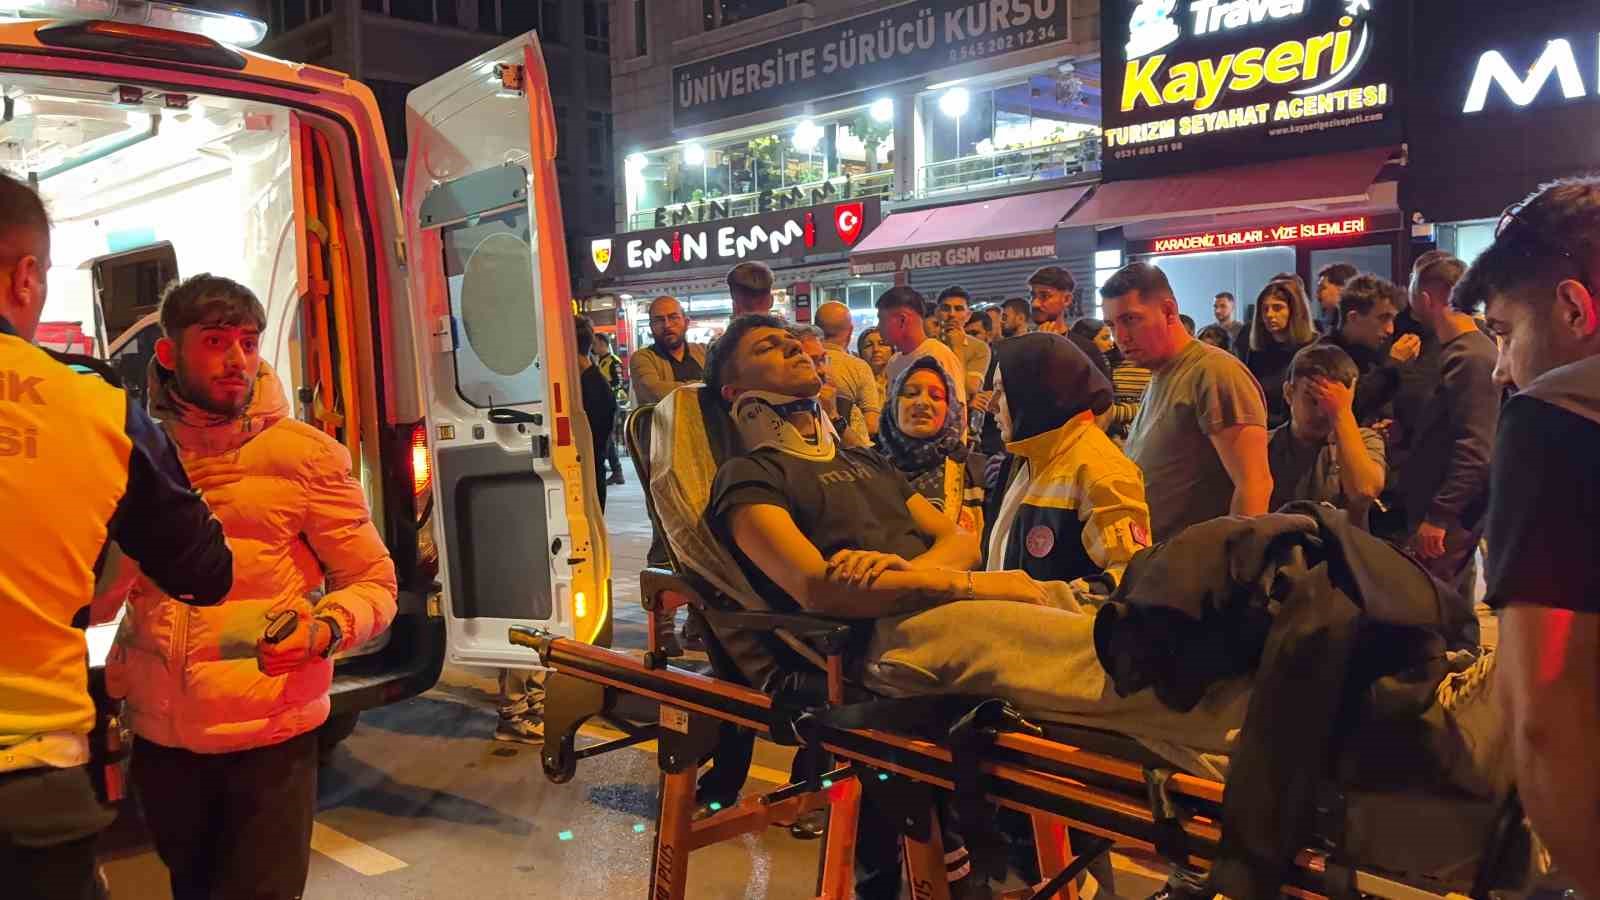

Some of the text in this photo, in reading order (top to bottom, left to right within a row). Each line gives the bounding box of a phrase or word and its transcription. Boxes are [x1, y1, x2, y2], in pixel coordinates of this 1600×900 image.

[679, 0, 1056, 108] ÜNİVERSİTE SÜRÜCÜ KURSU
[988, 35, 1014, 53] 202
[1018, 30, 1034, 46] 12
[1039, 24, 1056, 41] 34
[1121, 16, 1353, 112] Kayseri
[1179, 102, 1270, 136] SEYAHAT
[1155, 233, 1215, 251] KARADENİZ
[1217, 230, 1263, 246] TURLARI
[1271, 225, 1297, 241] VİZE
[900, 250, 942, 270] AKER
[945, 246, 981, 265] GSM
